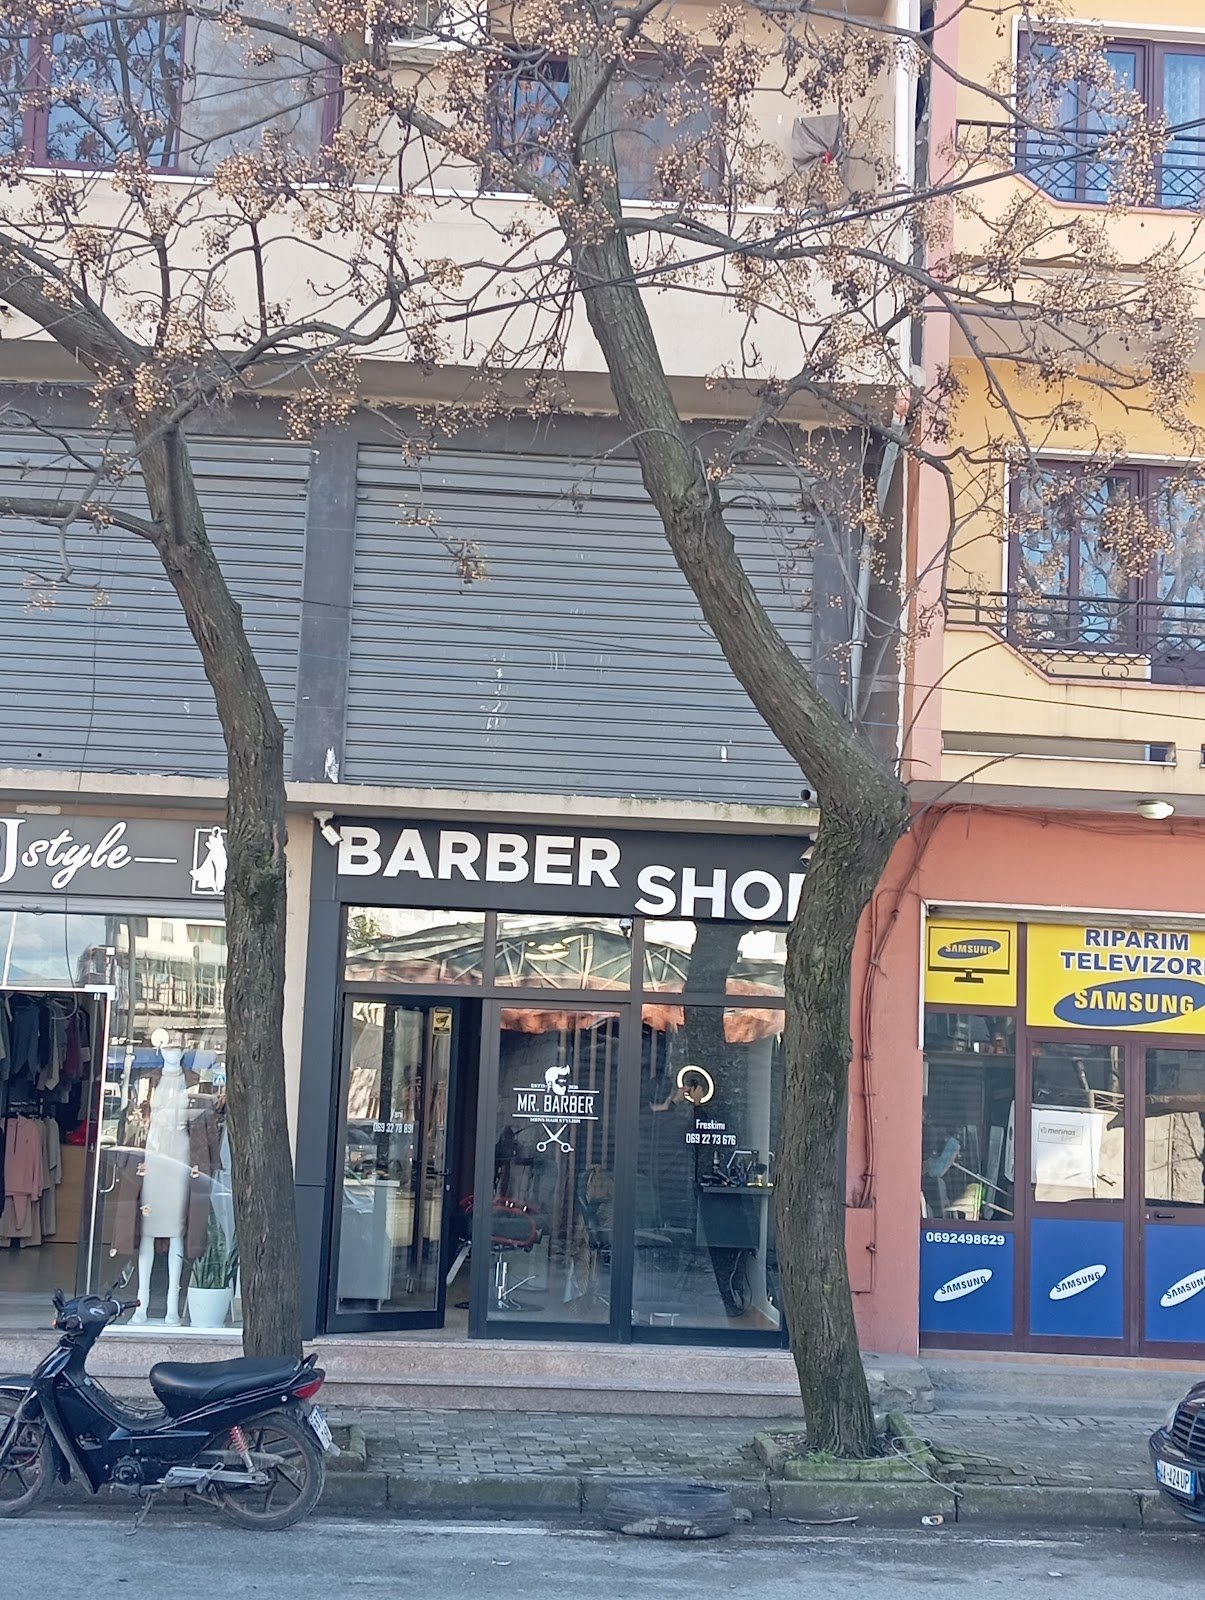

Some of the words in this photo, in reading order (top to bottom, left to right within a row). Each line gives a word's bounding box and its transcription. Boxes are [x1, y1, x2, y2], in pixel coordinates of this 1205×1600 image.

[337, 825, 622, 888] BARBER
[945, 943, 994, 955] SAMSUNG
[1084, 928, 1190, 952] RIPARIM
[1060, 950, 1205, 976] TELEVIZOR
[1074, 988, 1195, 1015] SAMSUNG
[517, 1093, 540, 1112] MR.
[543, 1094, 594, 1114] BARBER
[685, 1132, 700, 1144] 069
[701, 1133, 711, 1145] 22
[711, 1134, 721, 1145] 73
[722, 1134, 737, 1146] 676
[925, 1231, 1005, 1246] 0692498629
[940, 1275, 987, 1295] SAMSUNG
[1055, 1271, 1101, 1293] SAMSUNG
[1166, 1276, 1205, 1300] SAMSUN
